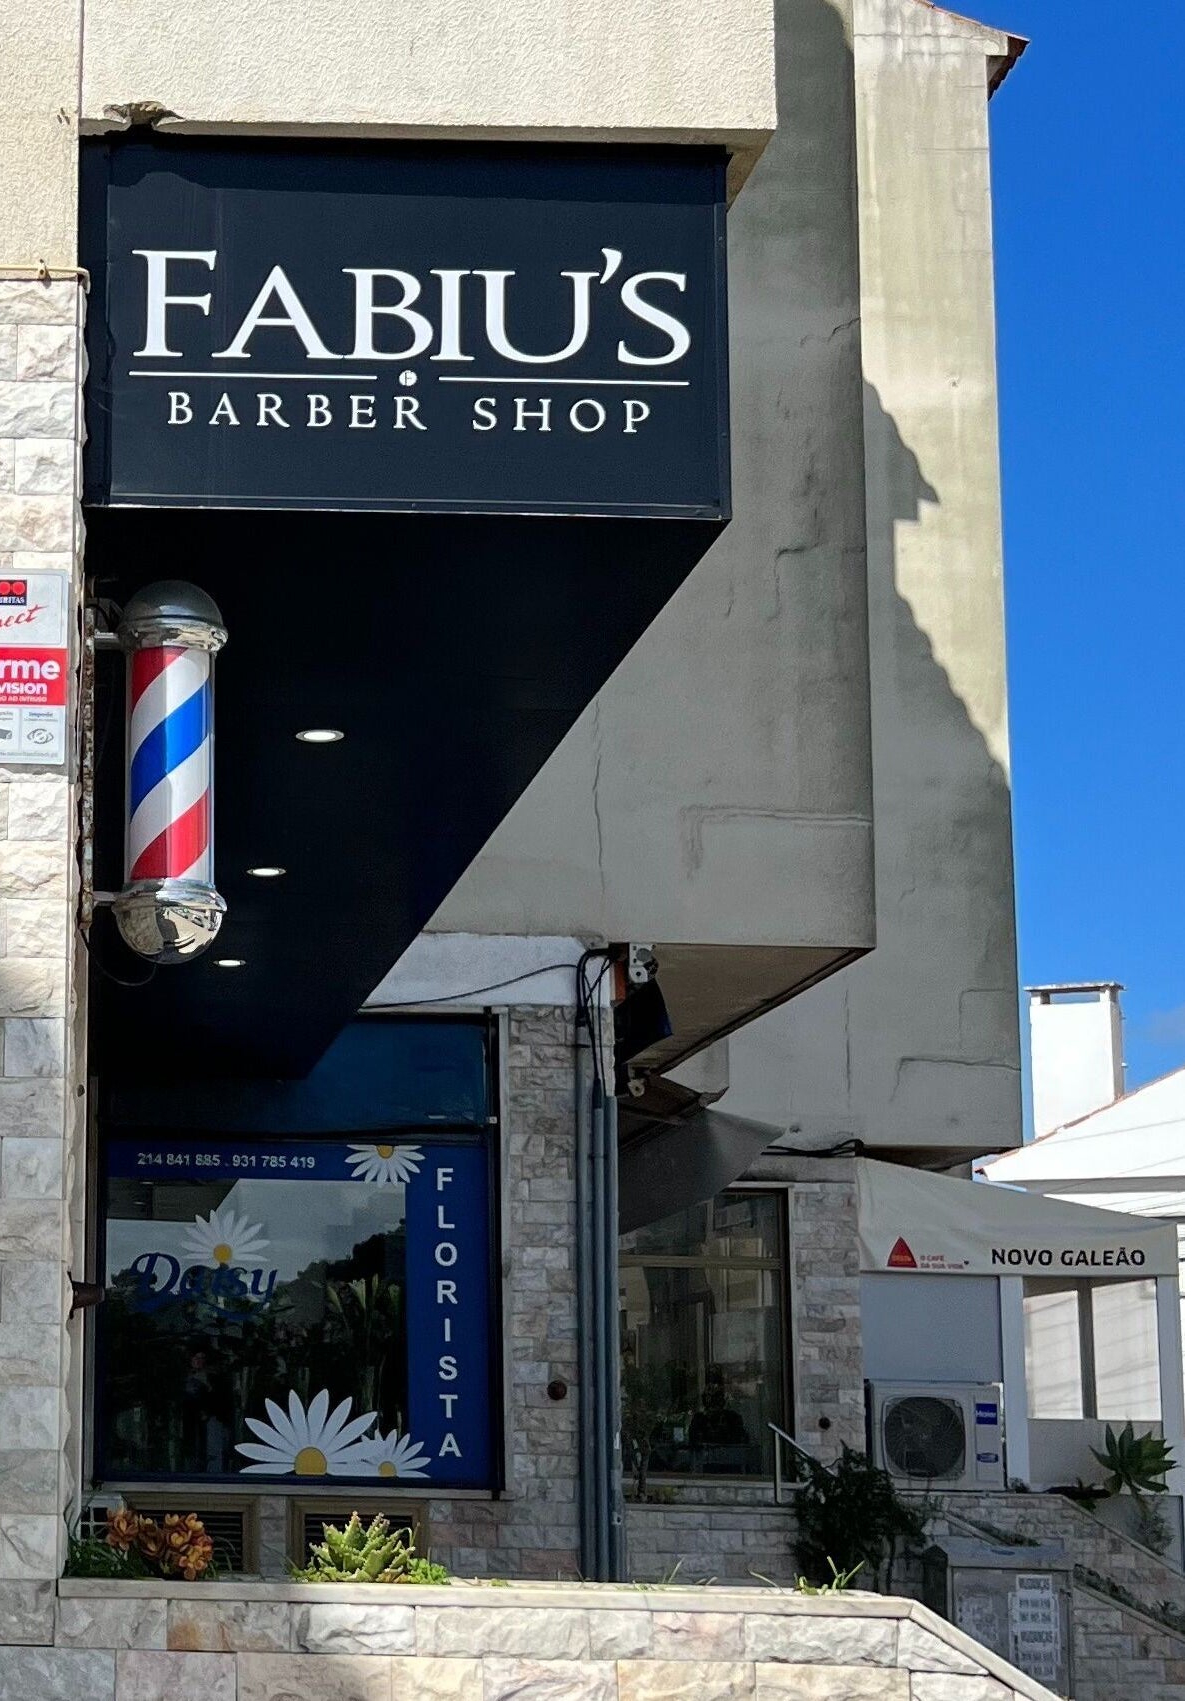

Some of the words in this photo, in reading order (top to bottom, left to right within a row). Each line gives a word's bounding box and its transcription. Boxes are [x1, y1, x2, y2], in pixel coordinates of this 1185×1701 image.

[132, 248, 691, 366] FABIU'S
[168, 392, 427, 430] BARBER
[472, 397, 651, 433] SHOP
[137, 1153, 163, 1165] 214
[166, 1153, 190, 1166] 841
[195, 1154, 221, 1167] 885
[232, 1154, 257, 1167] 931
[261, 1155, 287, 1168] 785
[290, 1156, 316, 1169] 419
[991, 1248, 1053, 1266] NOVO
[1060, 1246, 1146, 1267] GALEÃO
[130, 1252, 278, 1320] Daisy
[434, 1167, 463, 1459] FLORISTA
